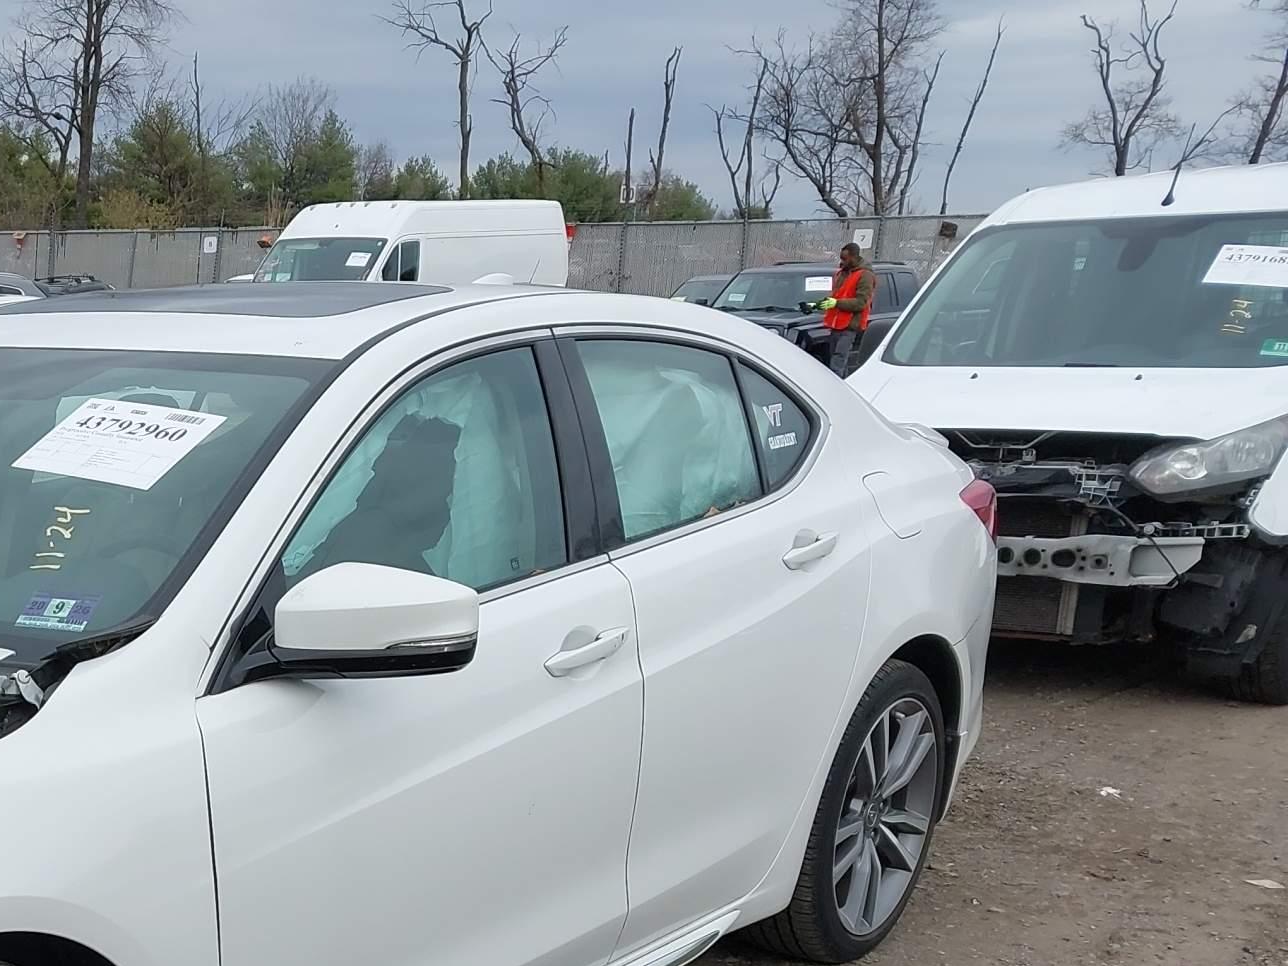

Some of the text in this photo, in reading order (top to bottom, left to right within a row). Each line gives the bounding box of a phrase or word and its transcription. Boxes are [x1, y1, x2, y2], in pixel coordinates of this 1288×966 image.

[1224, 253, 1288, 264] 4379168
[763, 403, 782, 427] VT
[75, 415, 189, 443] 43792960
[52, 600, 66, 616] 9
